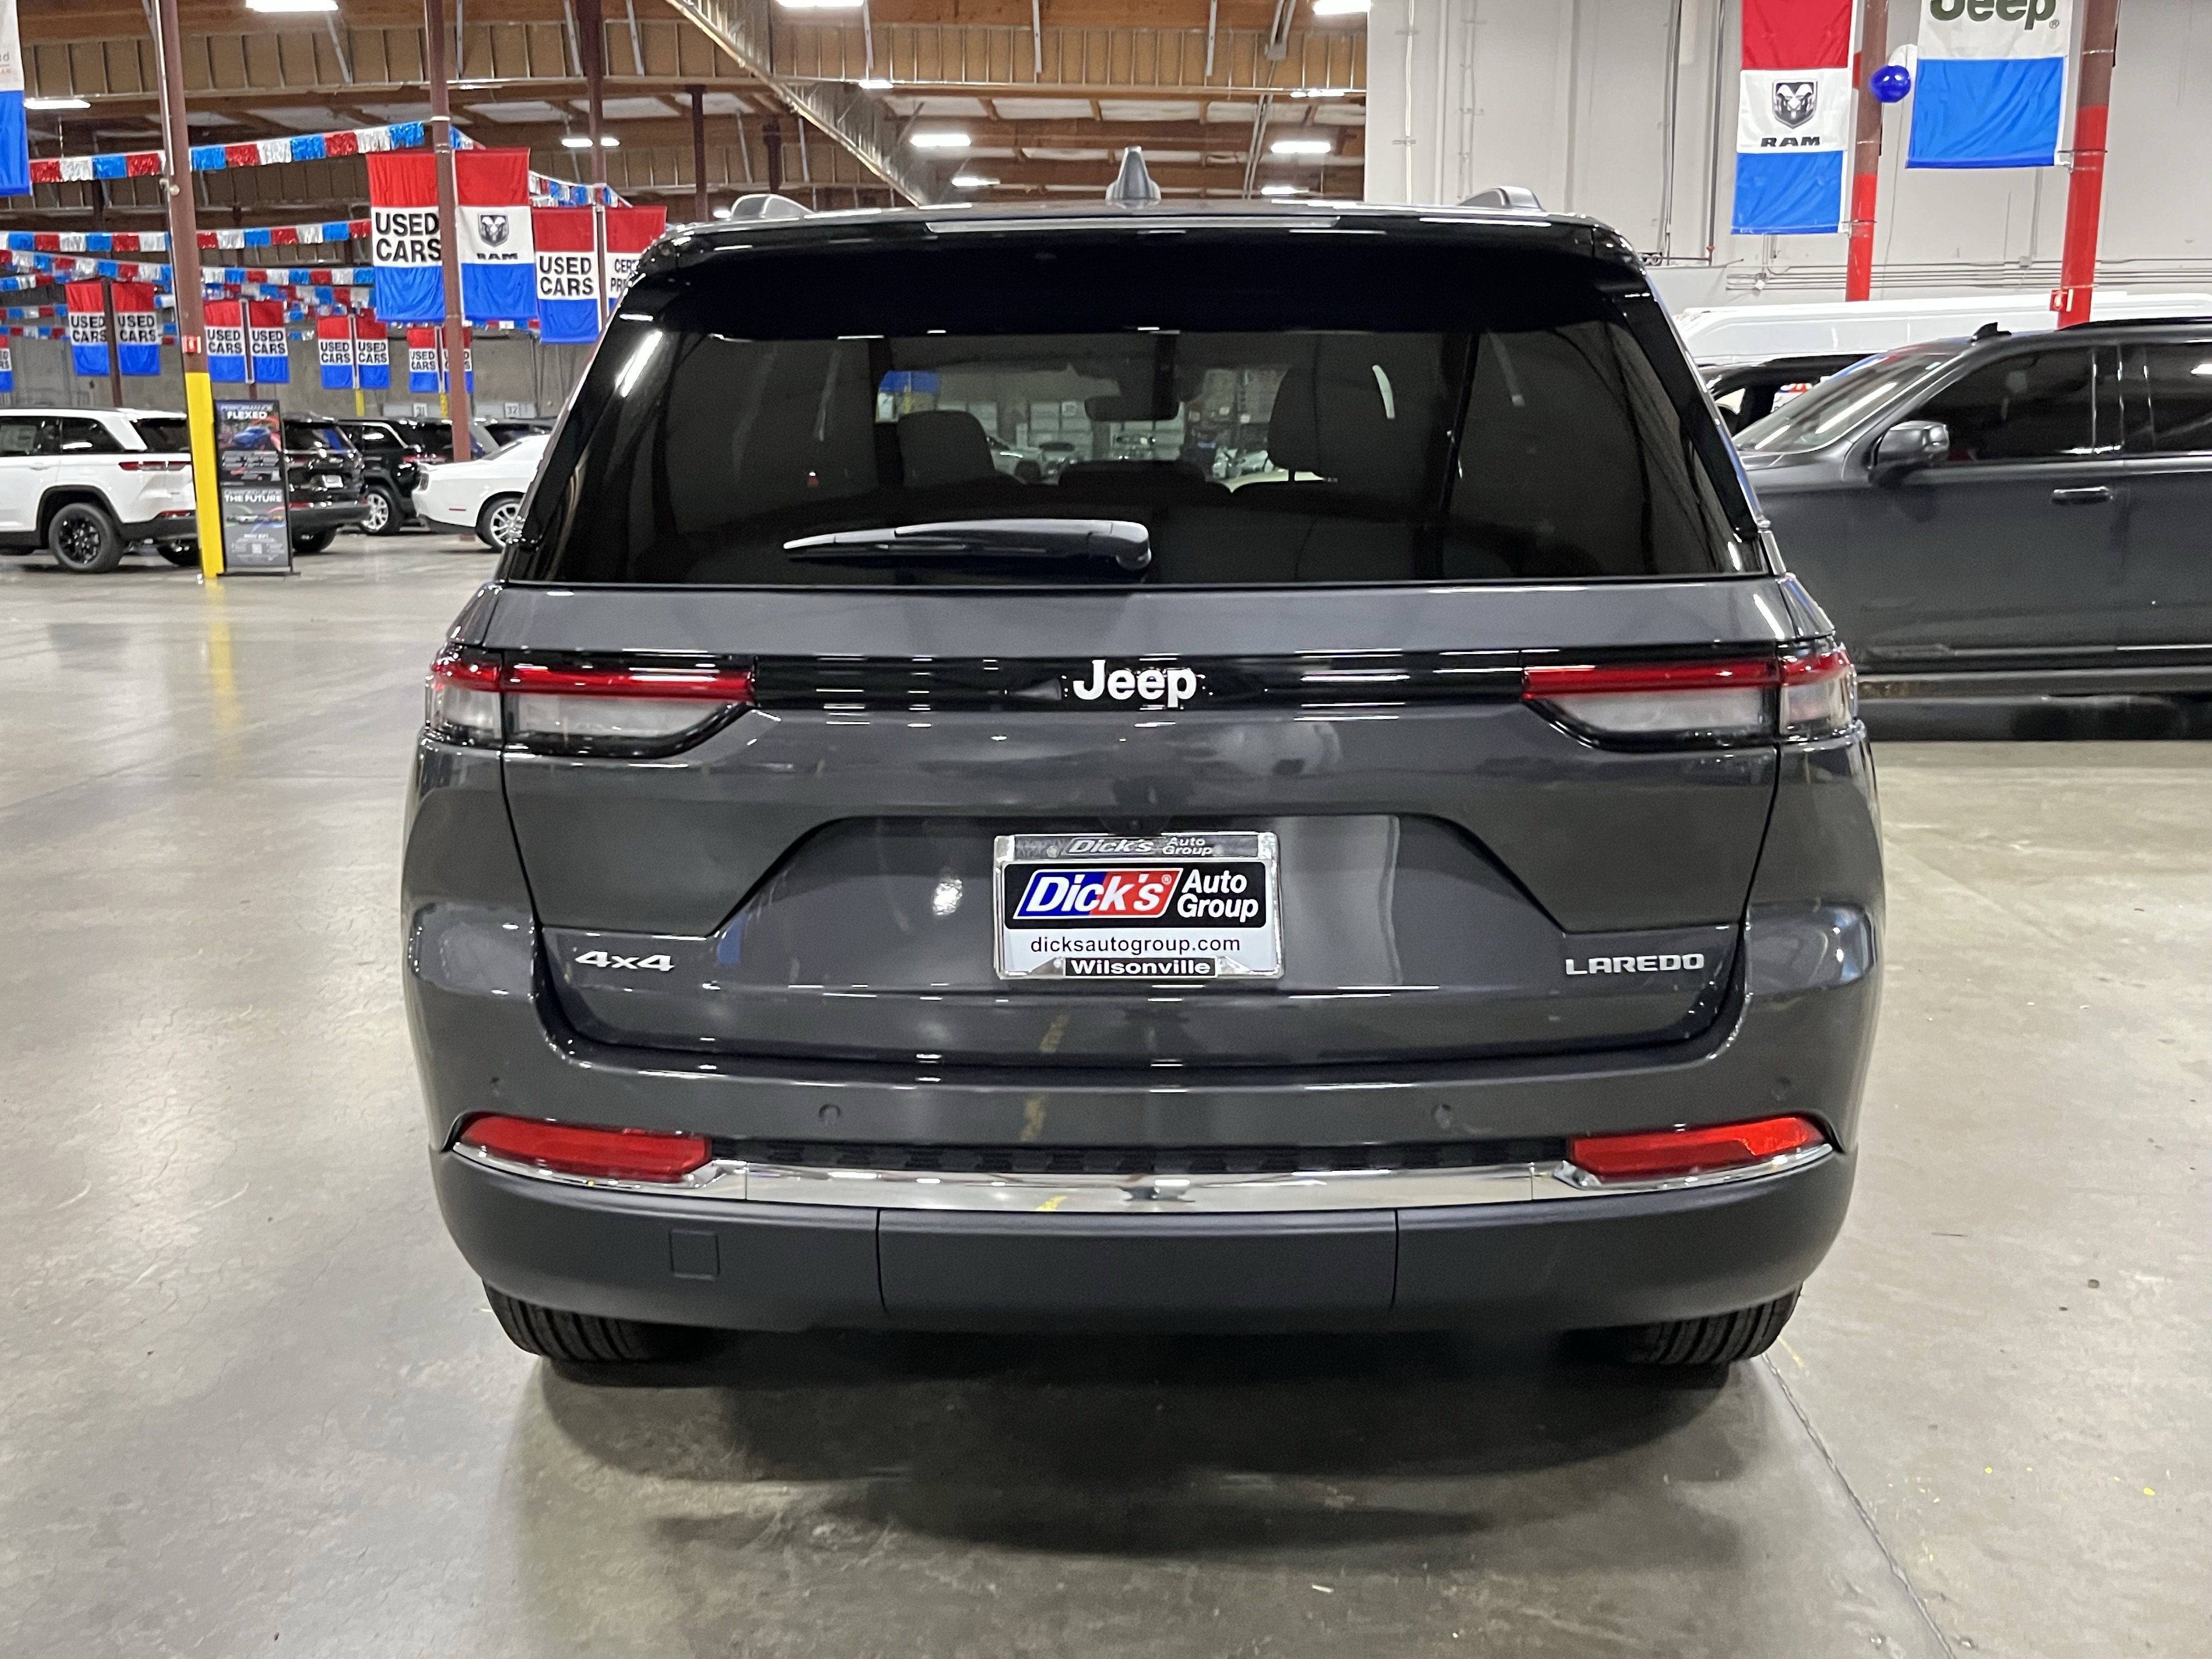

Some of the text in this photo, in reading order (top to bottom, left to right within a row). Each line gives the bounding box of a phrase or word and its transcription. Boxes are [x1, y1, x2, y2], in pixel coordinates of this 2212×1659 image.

[1760, 136, 1820, 147] RAM
[375, 212, 439, 236] USED
[376, 238, 441, 262] CARS
[539, 256, 592, 275] USED
[540, 276, 594, 296] CARS
[71, 315, 105, 328] USED
[117, 315, 155, 328] USED
[72, 330, 106, 342] CARS
[120, 330, 156, 342] CARS
[207, 329, 241, 341] USED
[252, 330, 284, 341] USED
[208, 342, 242, 354] CARS
[252, 343, 286, 354] CARS
[320, 341, 349, 352] USED
[358, 341, 387, 352] USED
[321, 353, 351, 363] CARS
[358, 353, 387, 363] CARS
[411, 351, 435, 360] USED
[411, 361, 436, 370] CARS
[227, 411, 268, 419] FLEXED
[1073, 659, 1197, 708] Jeep
[1069, 839, 1154, 853] Dick's
[1168, 837, 1206, 846] Auto
[1162, 845, 1212, 855] Group
[1182, 870, 1247, 894] Auto
[1025, 873, 1164, 912] Dick's
[1177, 893, 1259, 922] Group
[1031, 936, 1240, 956] dicksautogroup.com
[575, 951, 675, 972] 4x4
[1070, 960, 1211, 974] Wilsonville
[1565, 953, 1704, 975] LAREDO
